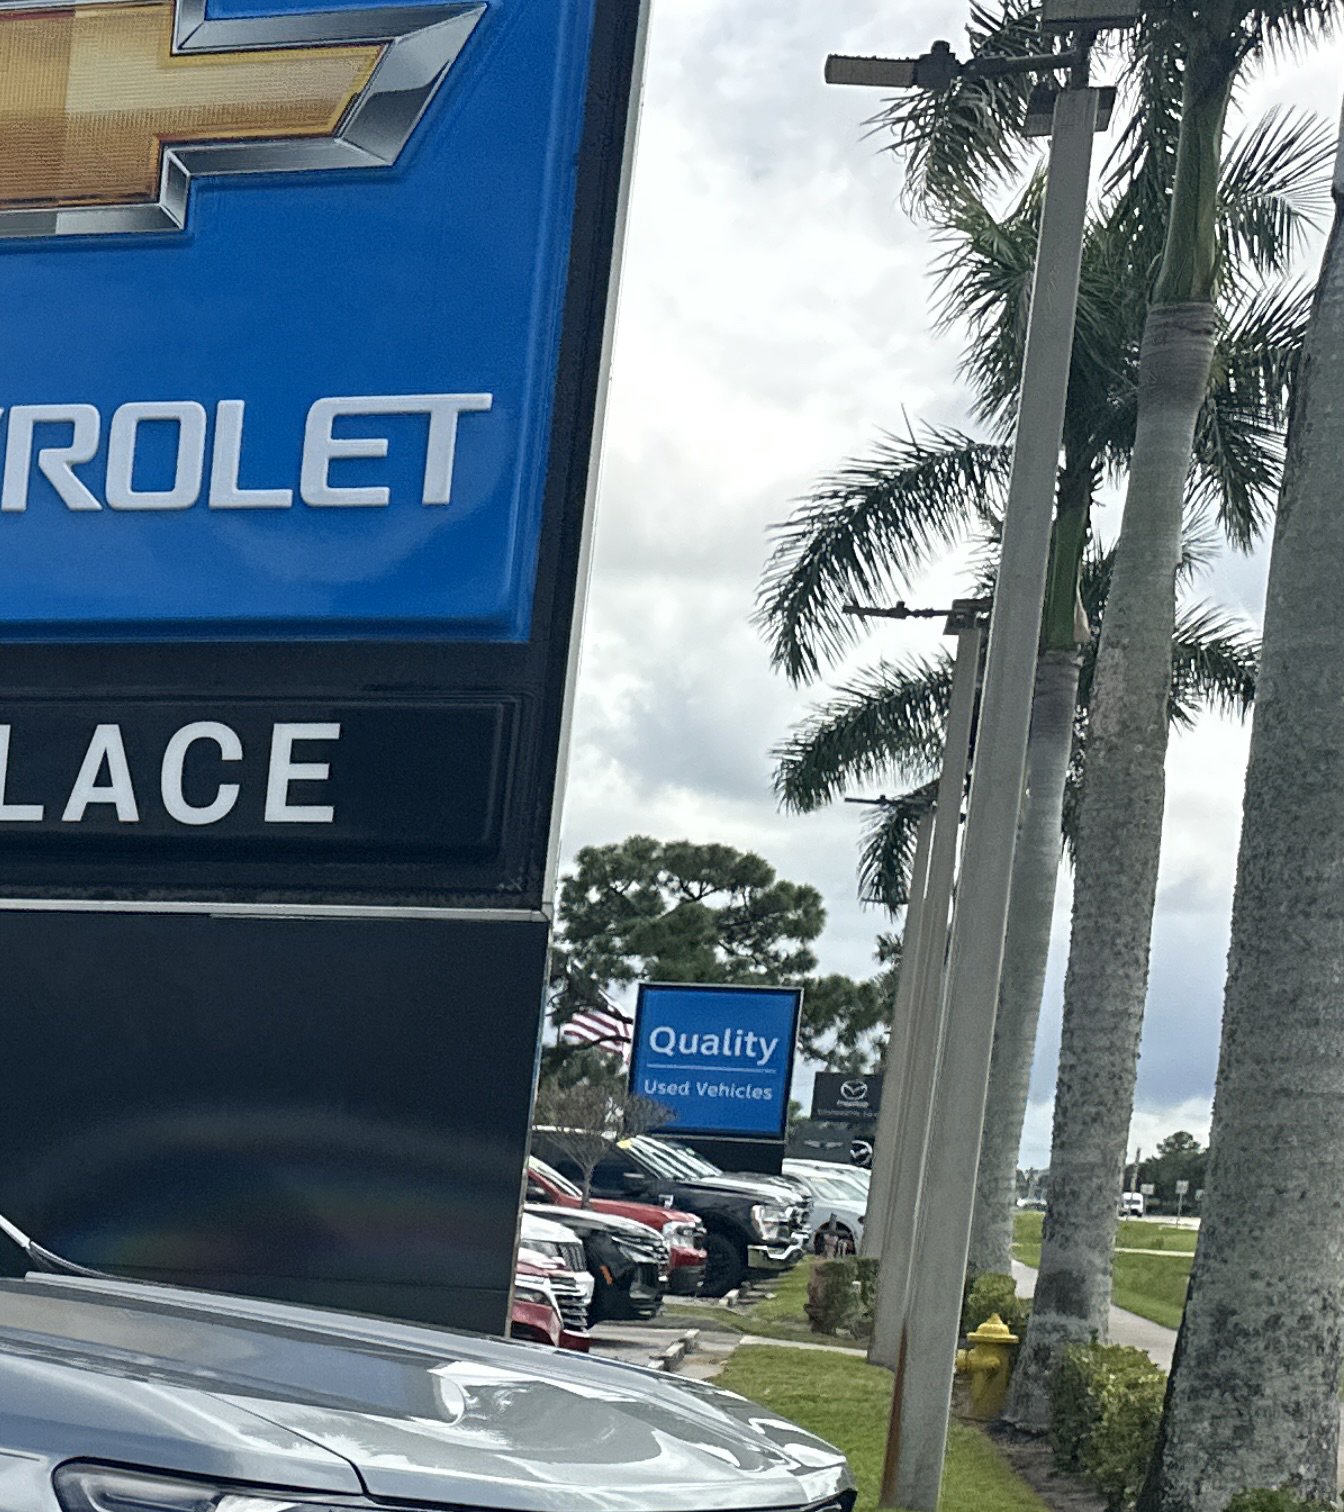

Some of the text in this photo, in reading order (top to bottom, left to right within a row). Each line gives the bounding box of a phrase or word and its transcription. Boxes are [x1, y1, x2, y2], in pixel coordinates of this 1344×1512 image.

[649, 1026, 778, 1066] Quality
[644, 1079, 773, 1100] Used Vehicles
